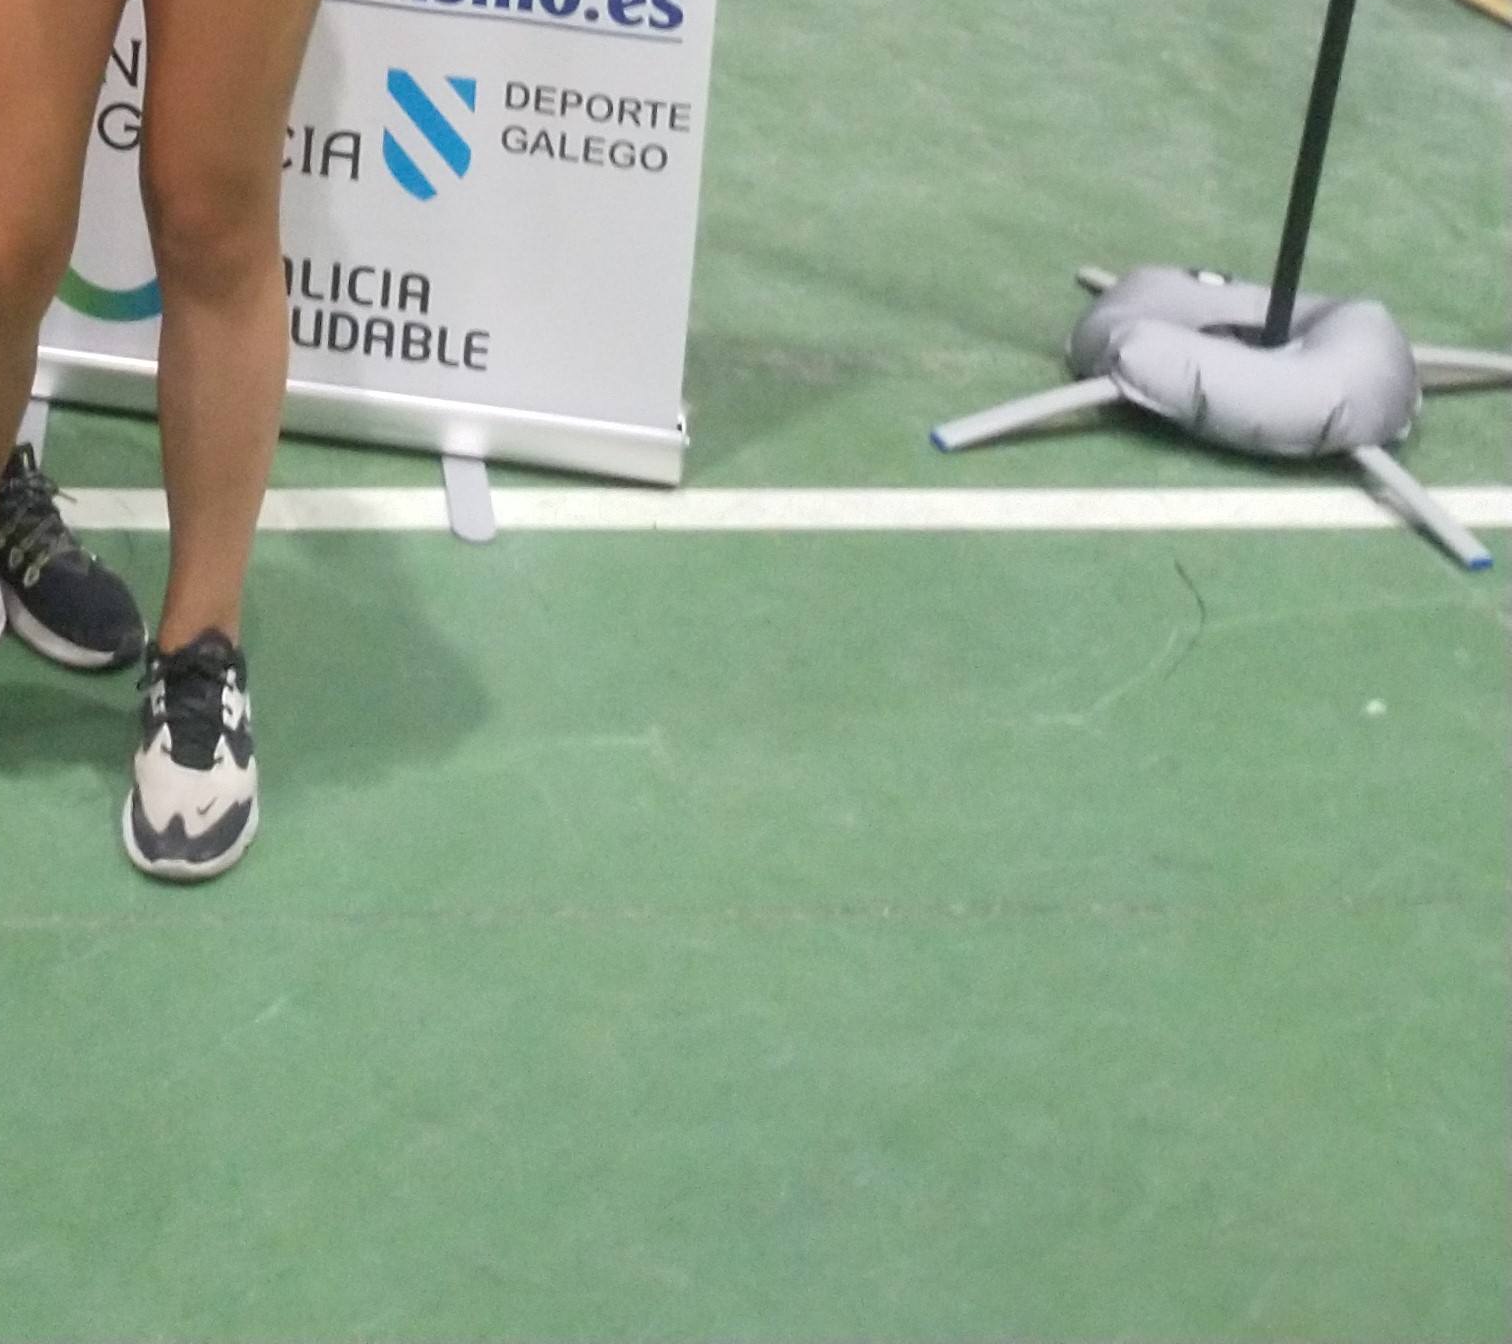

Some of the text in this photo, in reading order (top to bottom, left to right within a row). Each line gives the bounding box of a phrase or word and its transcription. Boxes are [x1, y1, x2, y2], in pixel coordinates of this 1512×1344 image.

[505, 81, 692, 133] DEPORTE
[501, 124, 669, 174] GALEGO
[283, 255, 430, 315] LICIA
[290, 305, 490, 372] UDABLE
